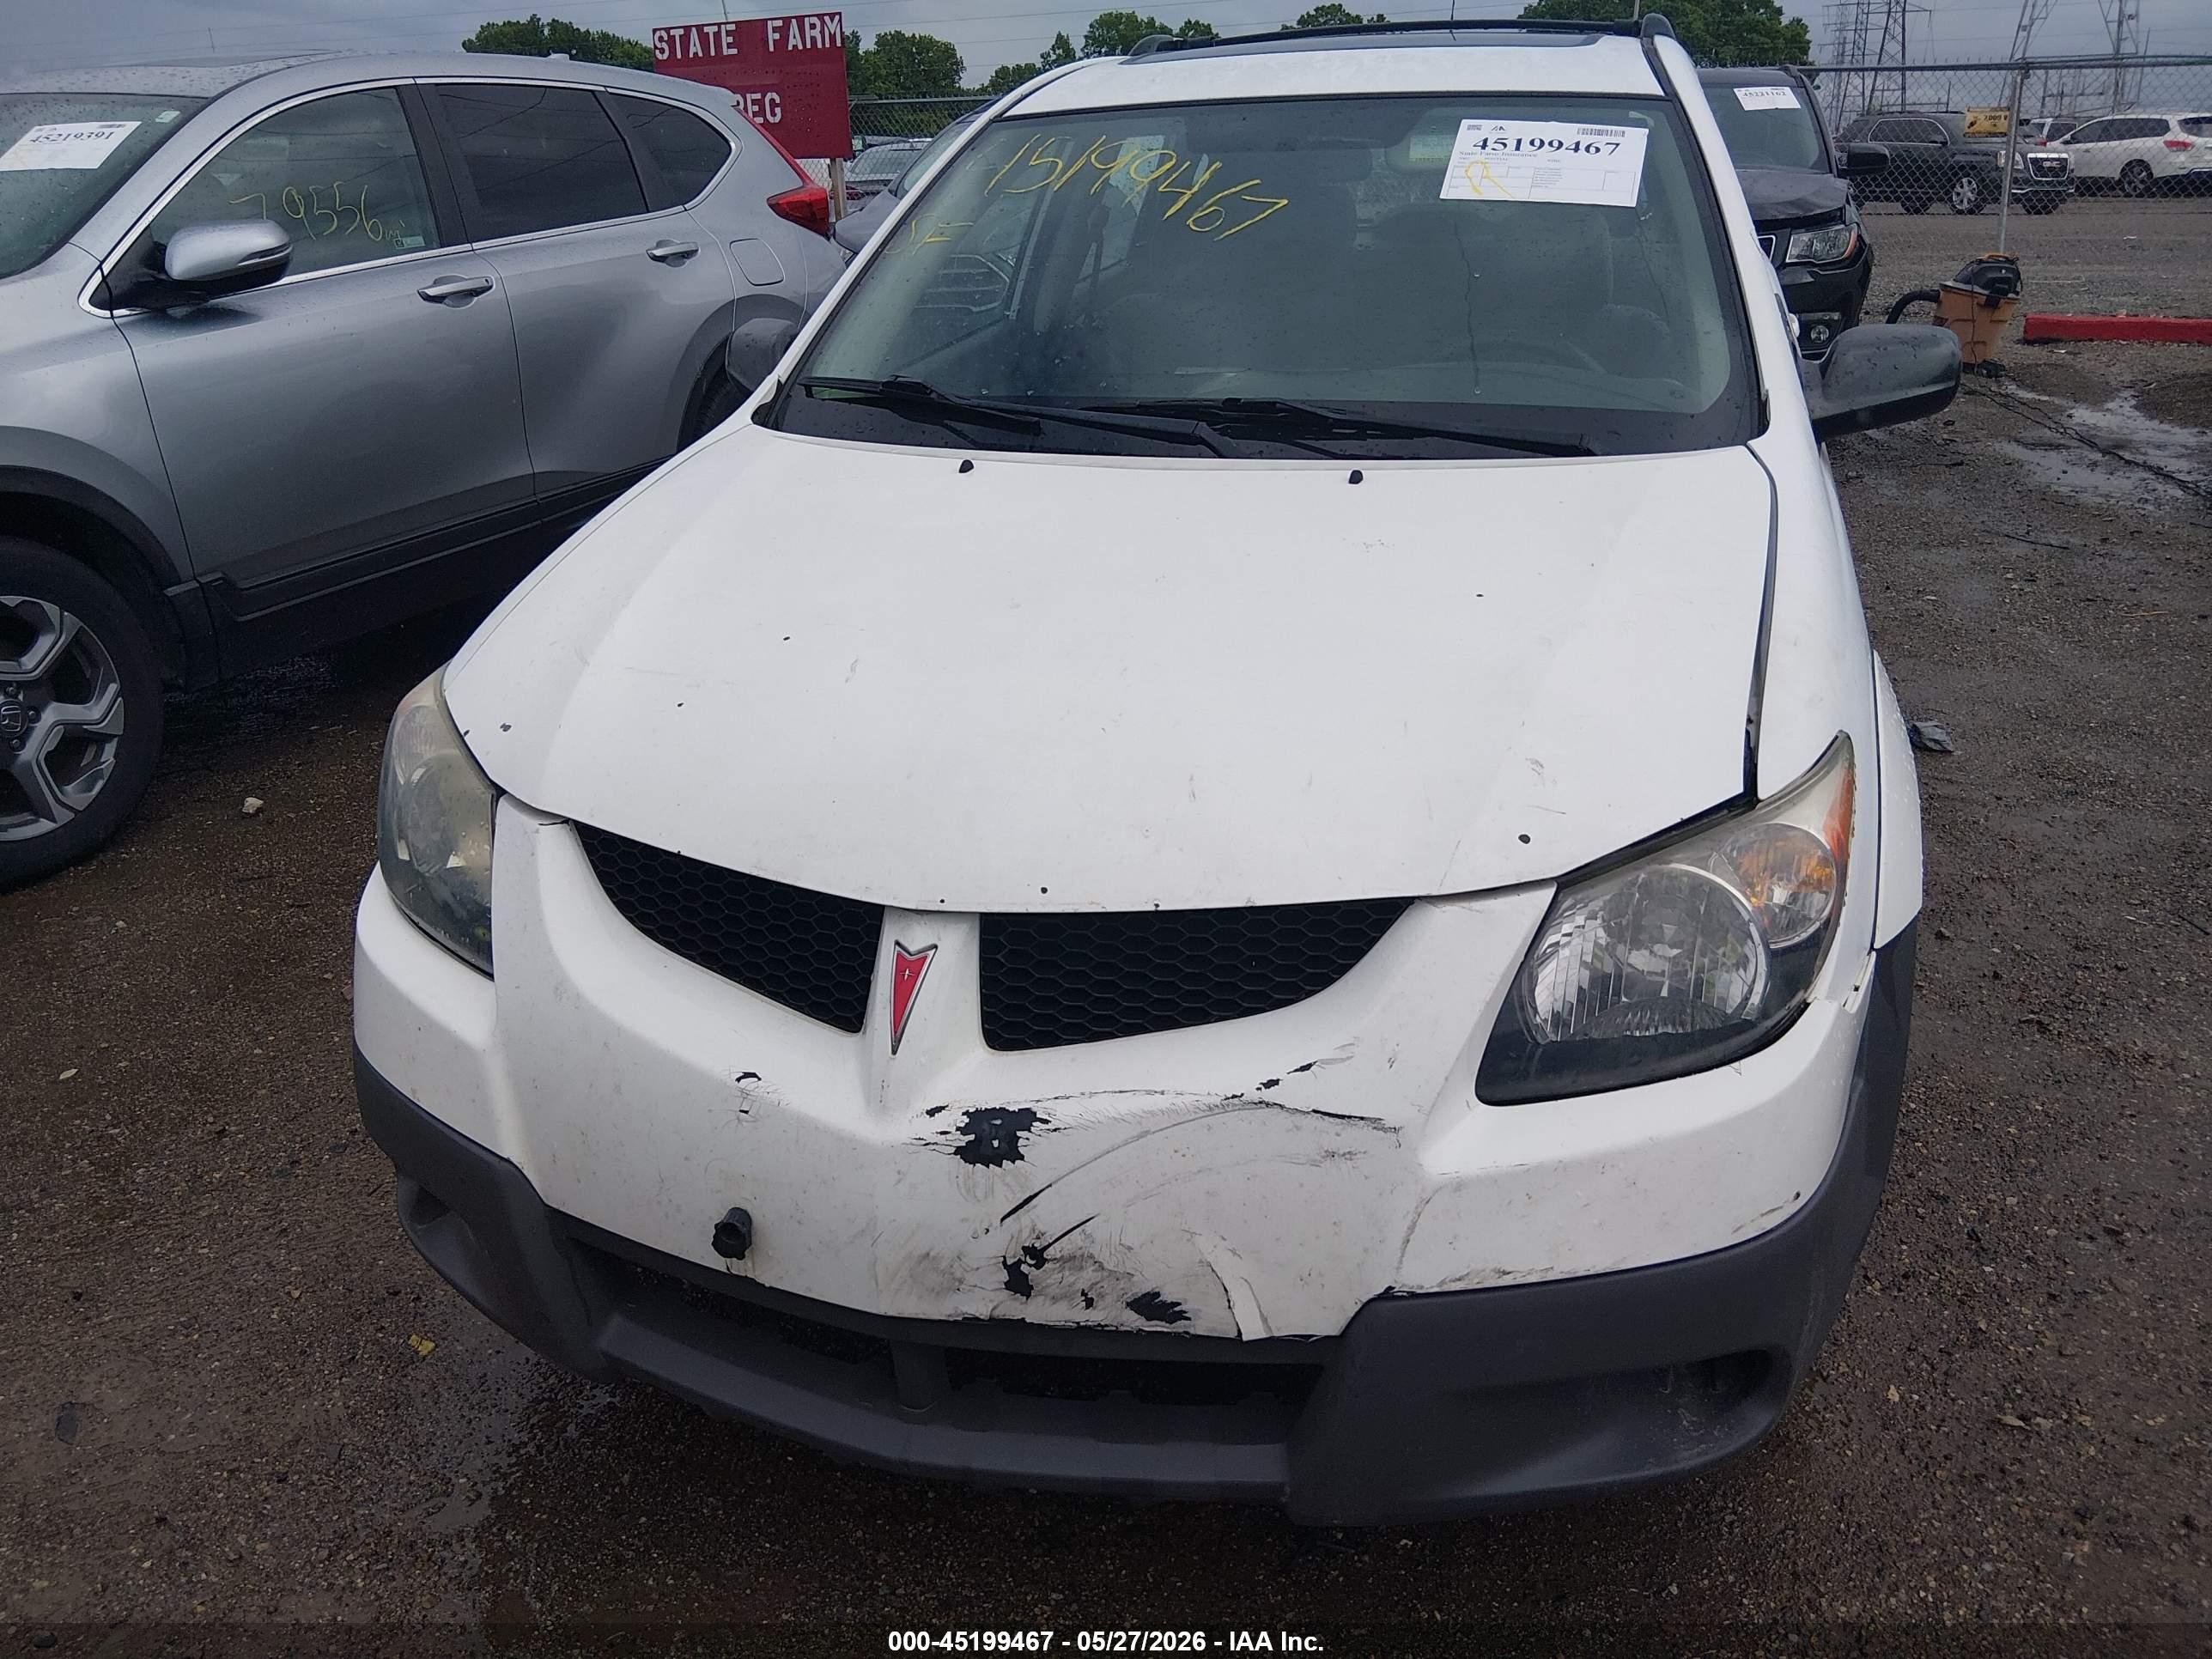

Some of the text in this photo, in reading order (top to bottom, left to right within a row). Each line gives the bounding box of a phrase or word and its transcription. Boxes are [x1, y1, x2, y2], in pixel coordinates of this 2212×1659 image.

[653, 15, 842, 60] STATE FARM
[29, 131, 116, 143] 45219391
[1472, 137, 1621, 156] 45199467
